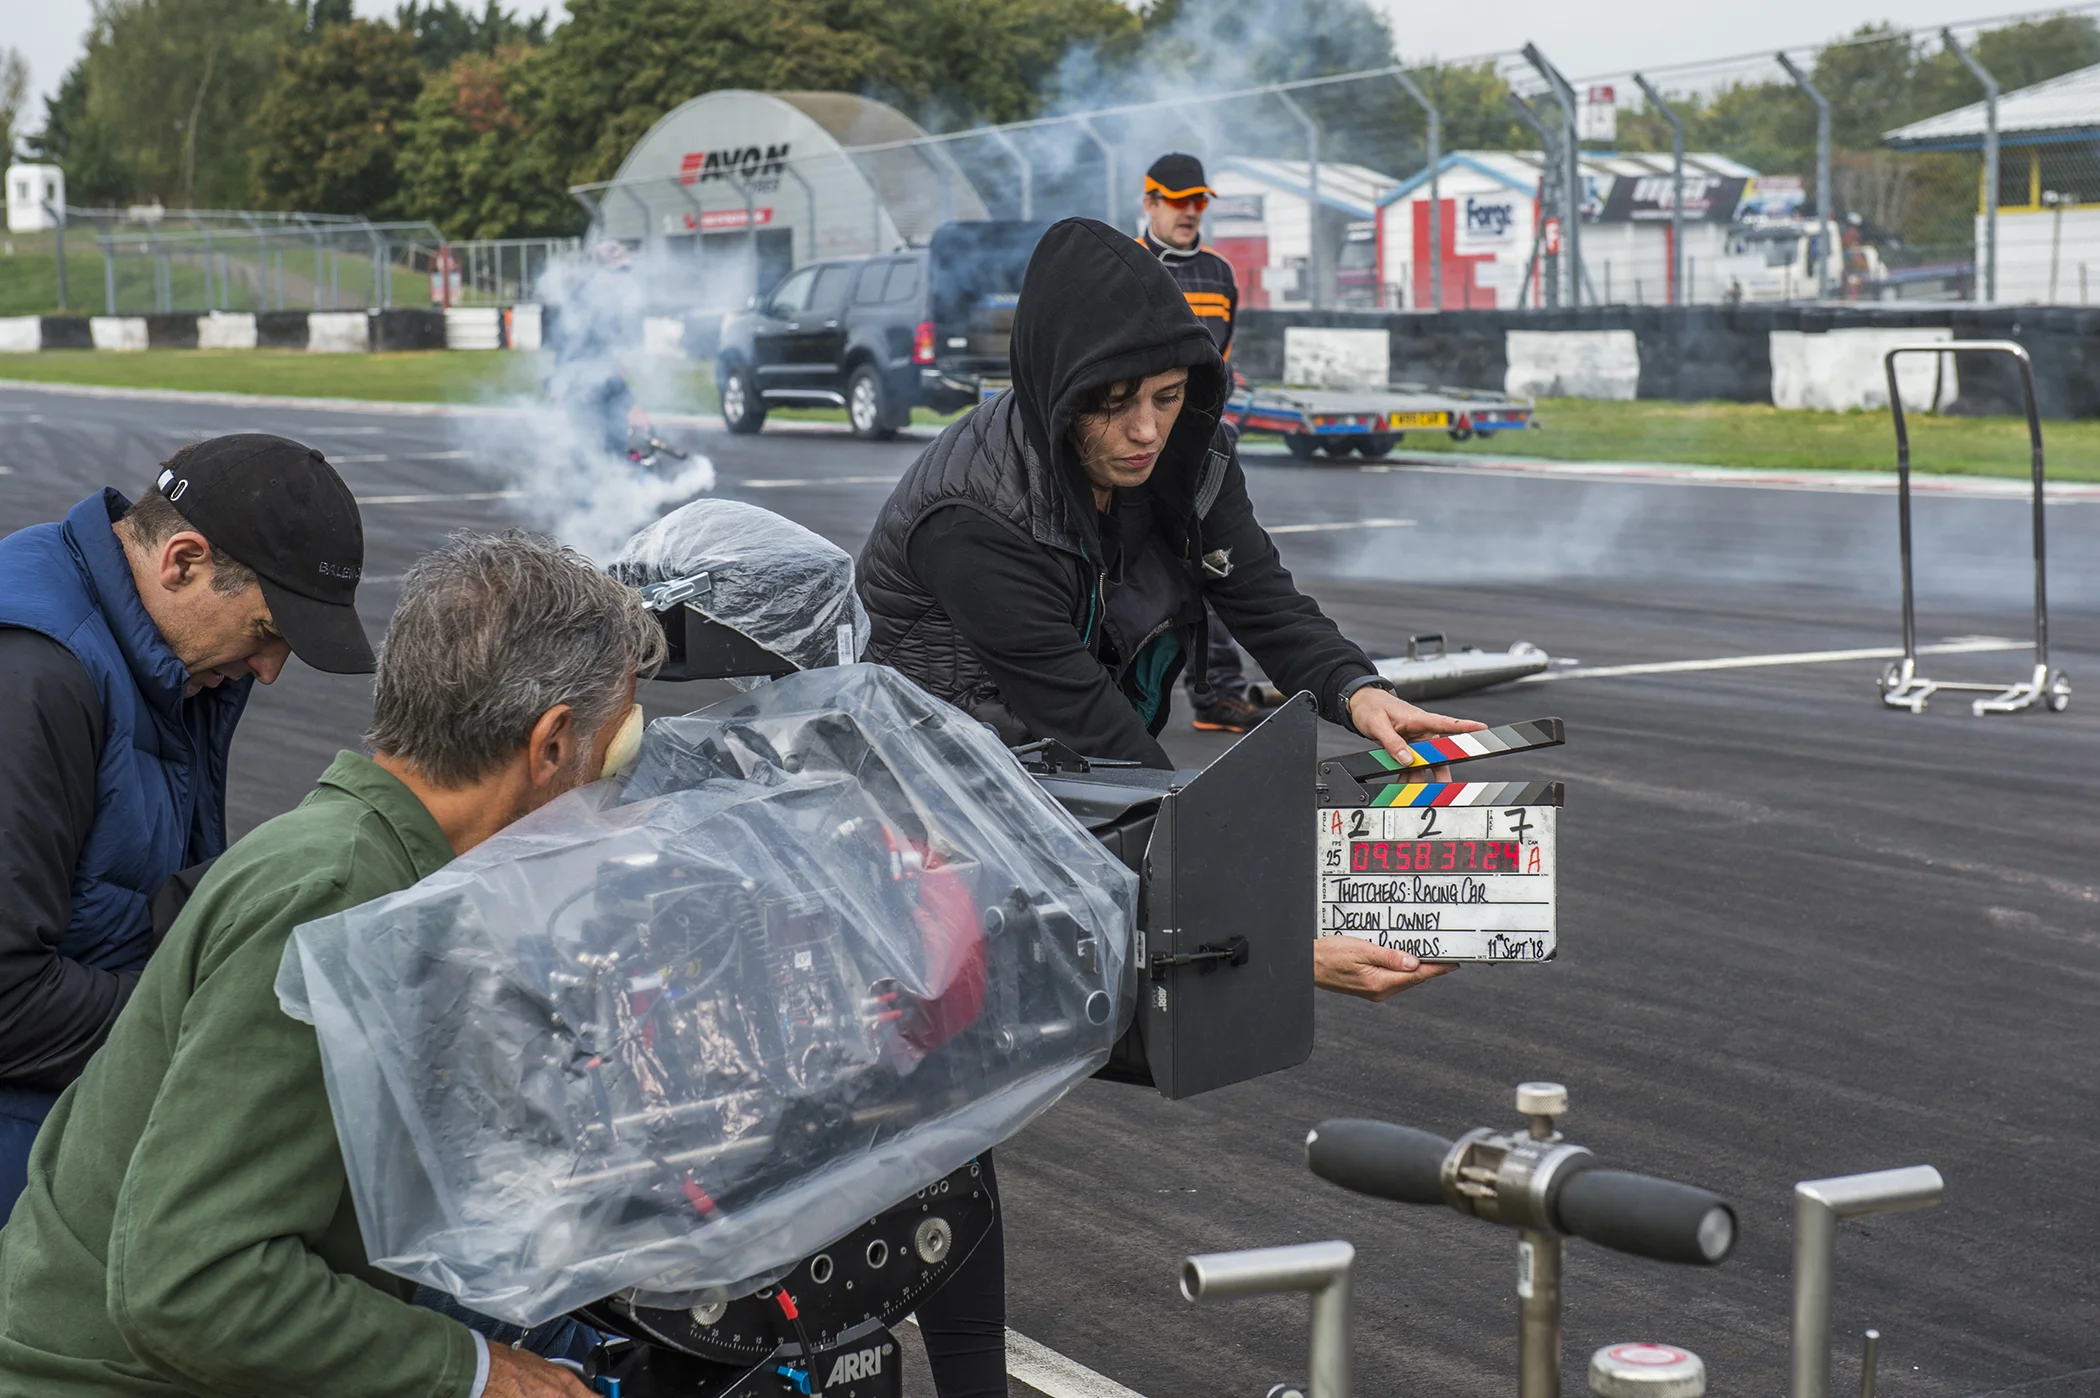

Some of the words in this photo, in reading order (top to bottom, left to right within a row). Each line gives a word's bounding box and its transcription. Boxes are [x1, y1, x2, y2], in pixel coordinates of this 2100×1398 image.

[702, 143, 790, 183] AVON
[1417, 807, 1442, 839] 2
[1504, 807, 1534, 845] 7
[1326, 849, 1342, 866] 25
[1528, 846, 1541, 874] A
[1413, 875, 1459, 905] RACING
[1462, 876, 1489, 903] CAR
[1332, 904, 1381, 931] DECLAN
[1388, 905, 1440, 930] LOWNEY
[824, 1345, 881, 1389] ARRI
